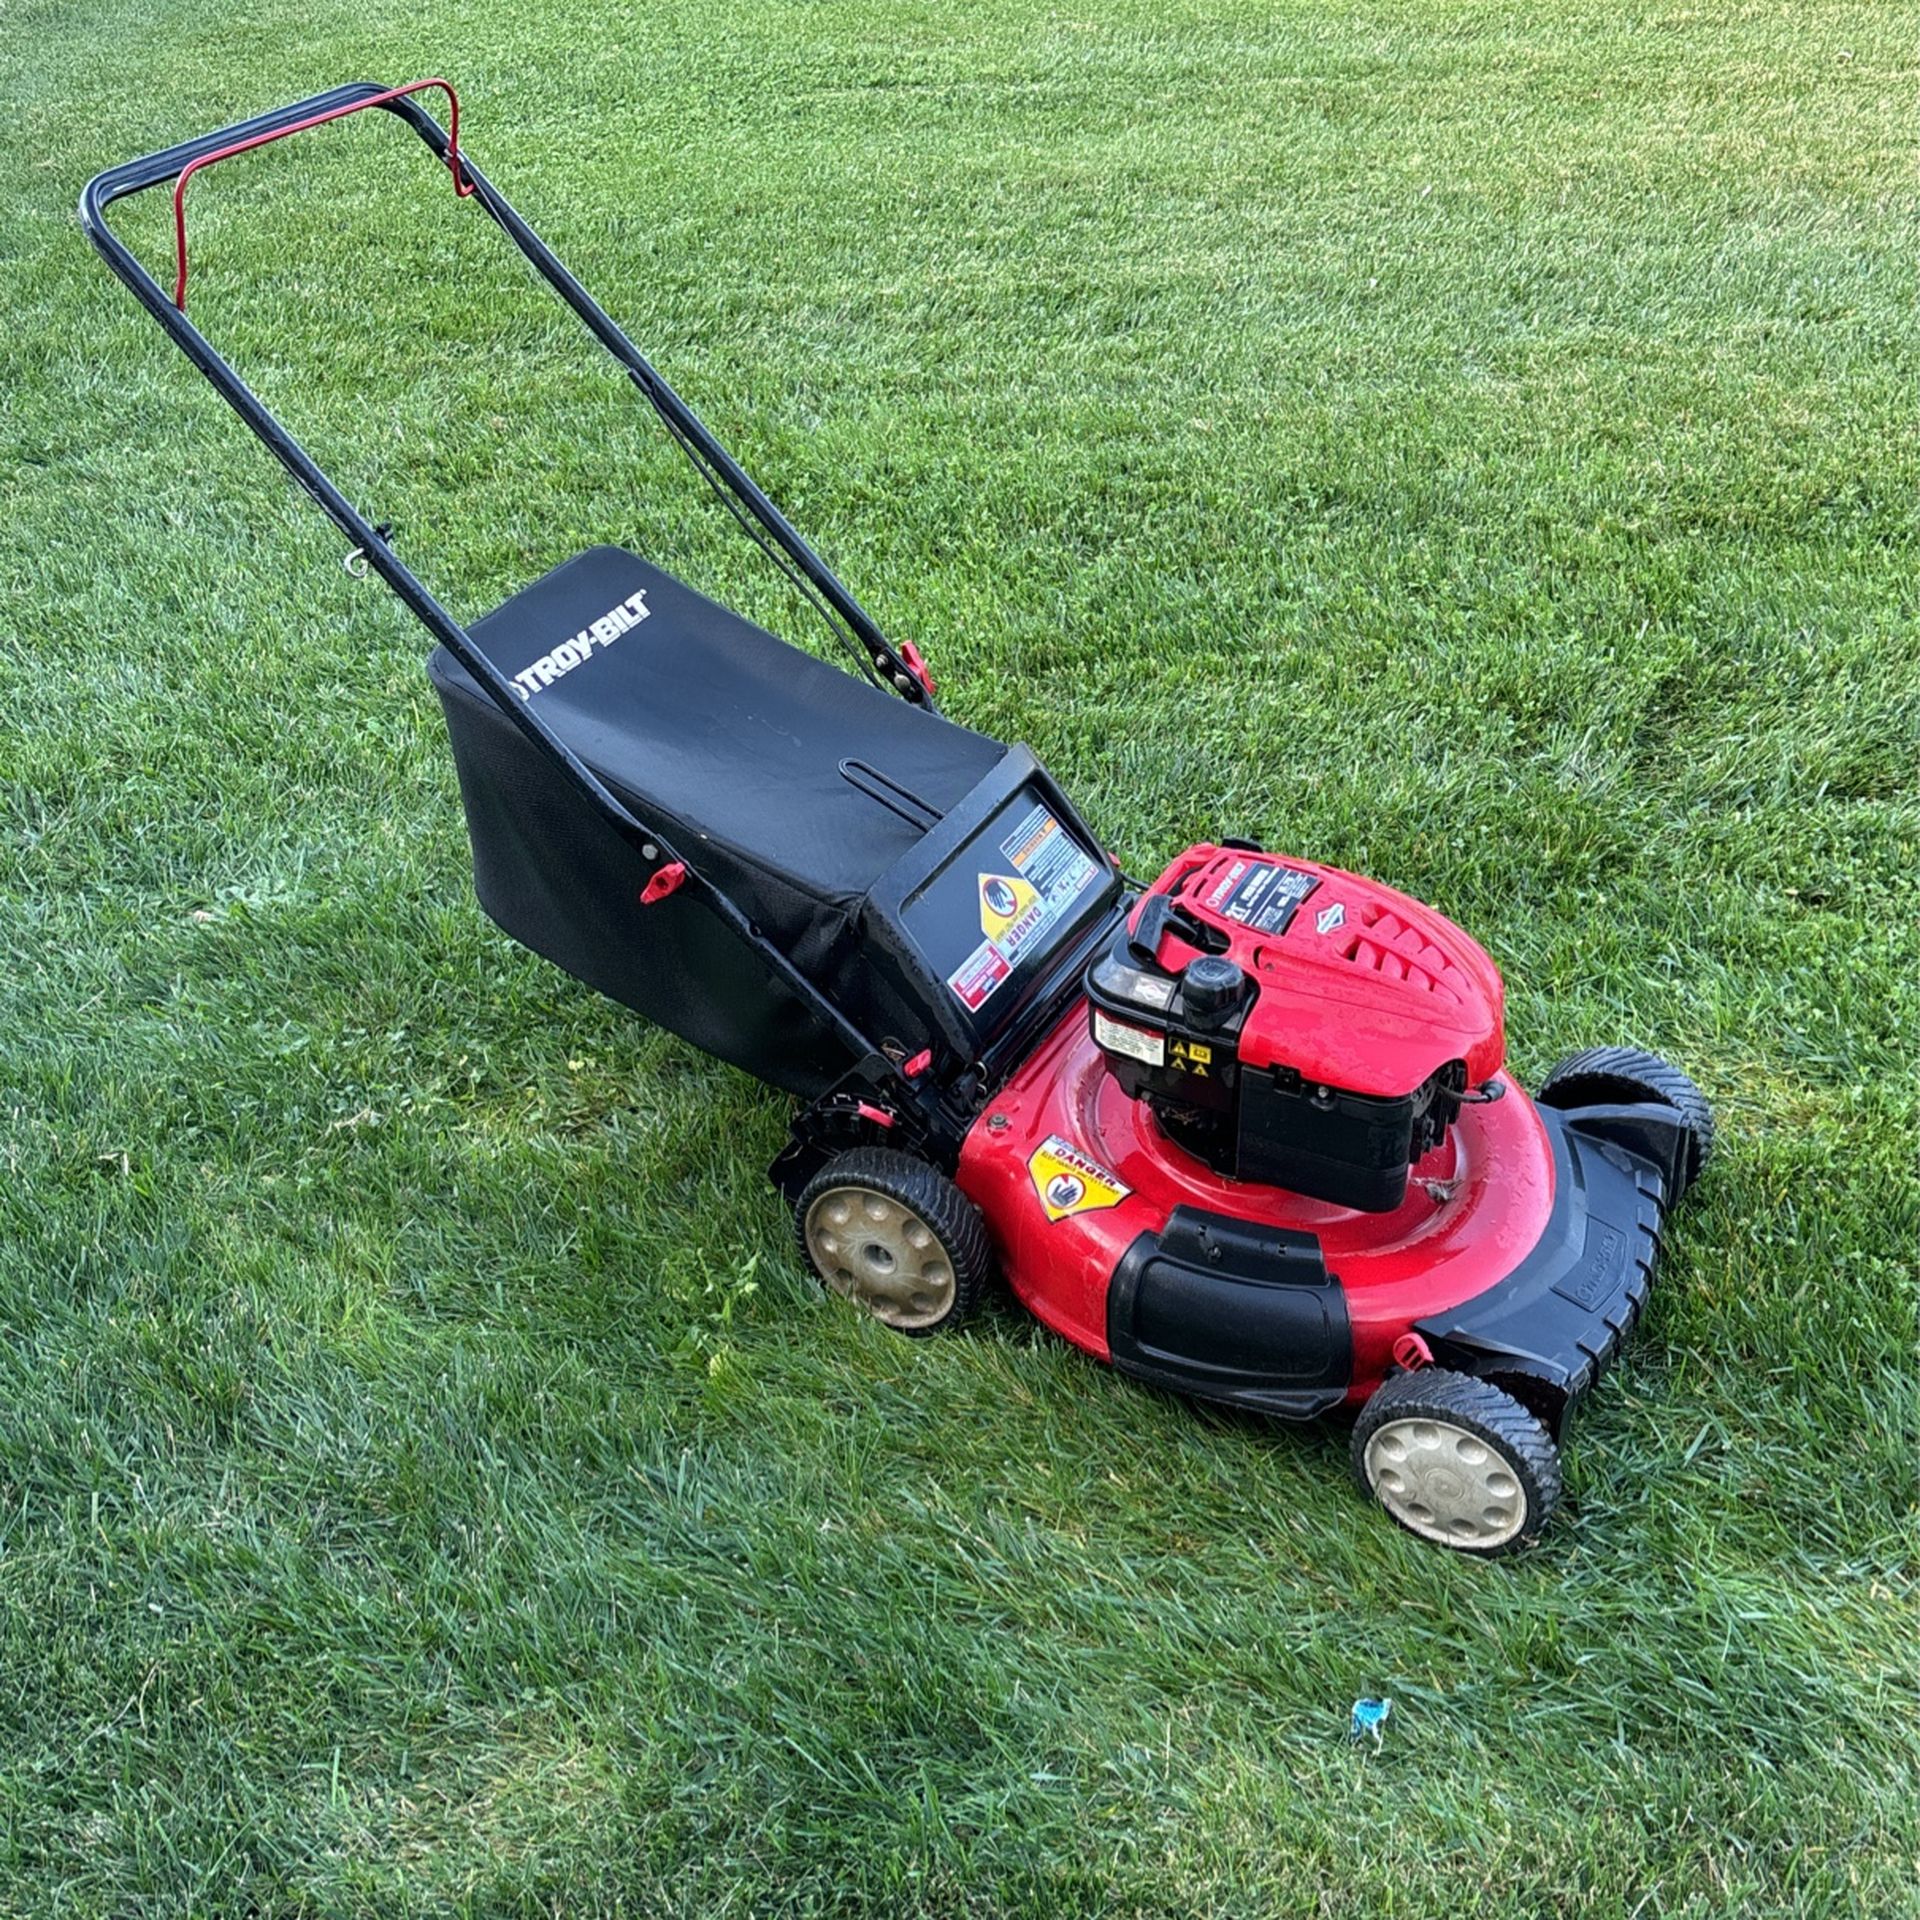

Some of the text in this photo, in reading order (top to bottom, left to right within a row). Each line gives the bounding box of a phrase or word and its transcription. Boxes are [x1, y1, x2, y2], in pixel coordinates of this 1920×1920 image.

[513, 590, 651, 694] TROY-BILT
[1006, 906, 1042, 947] DANGER
[1054, 1147, 1117, 1187] DANGER
